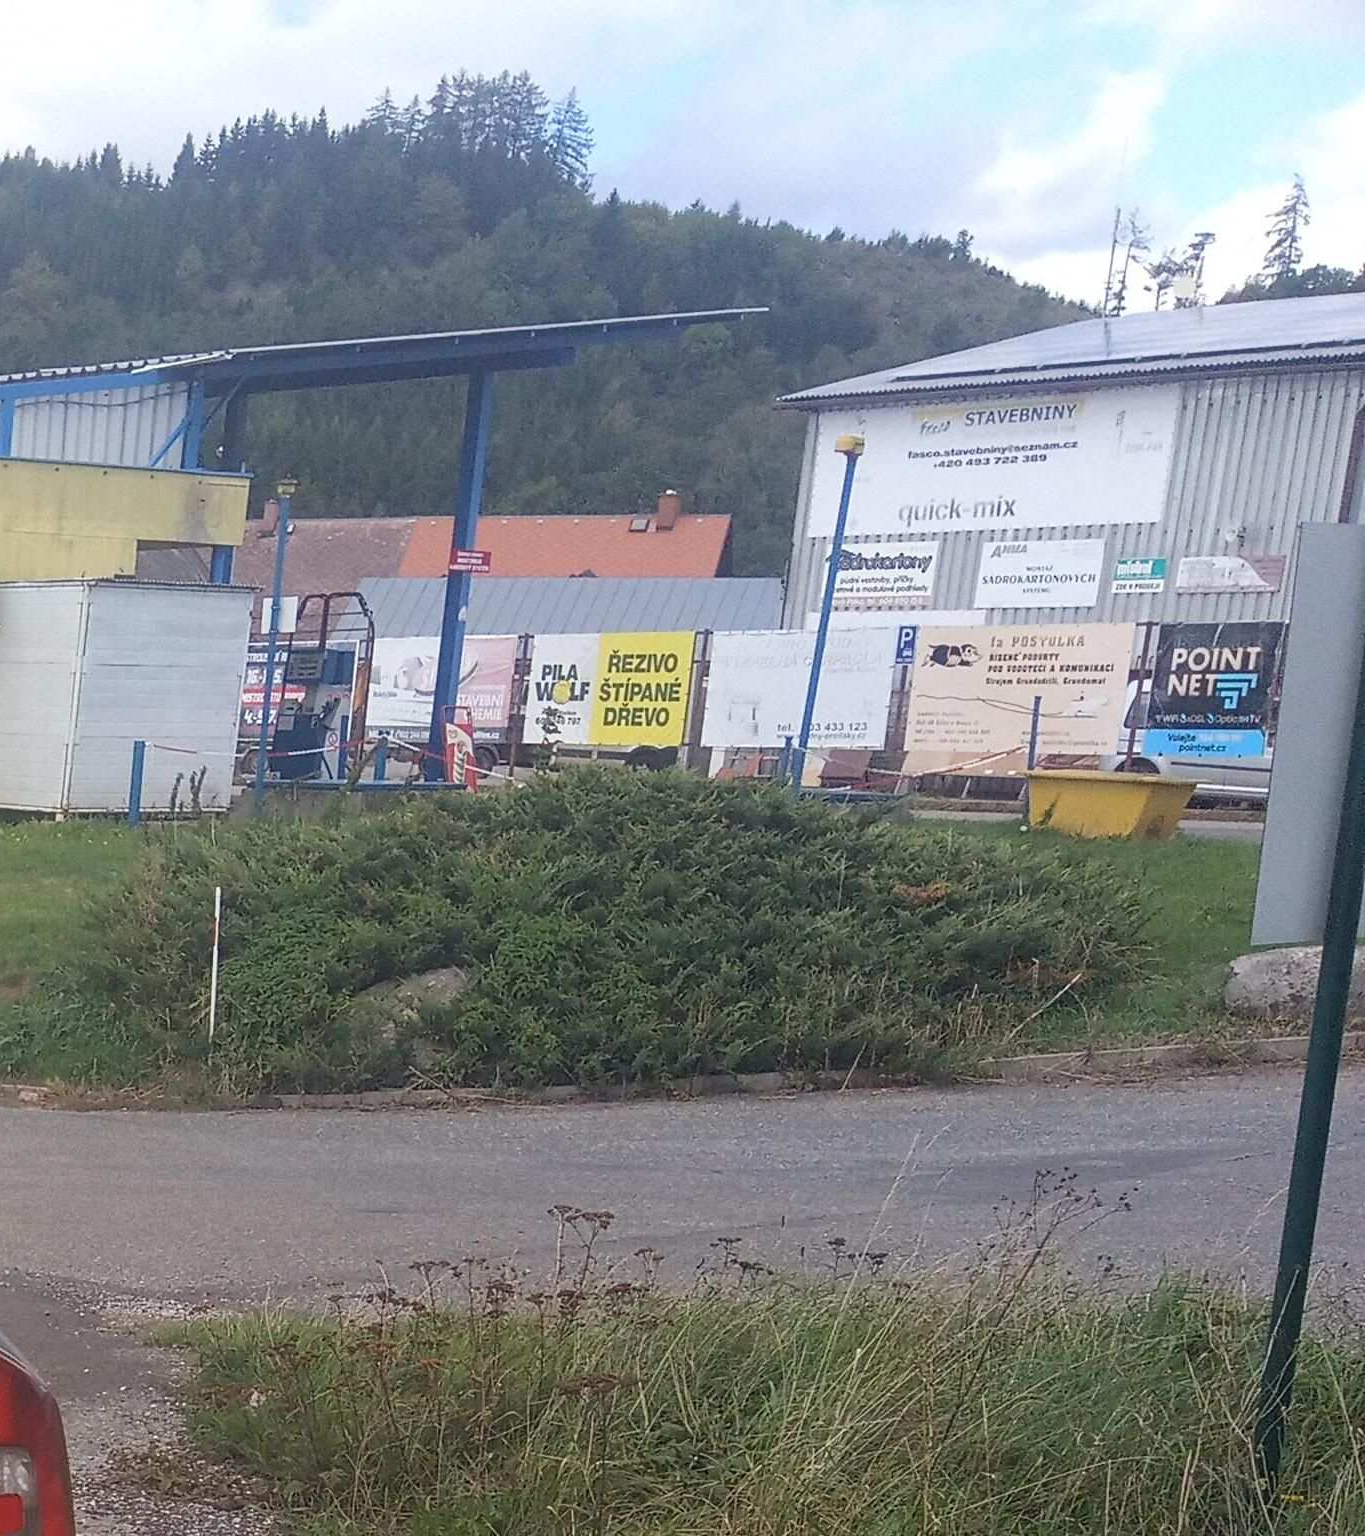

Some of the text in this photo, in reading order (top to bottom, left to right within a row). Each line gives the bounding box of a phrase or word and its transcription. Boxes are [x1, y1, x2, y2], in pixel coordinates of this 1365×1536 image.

[965, 404, 1077, 426] STAVEBNINY
[966, 458, 990, 466] 493
[898, 495, 1016, 527] quick-mix
[901, 629, 913, 648] P
[607, 650, 678, 673] ŘEZIVO
[1171, 647, 1261, 671] POINT
[541, 664, 579, 681] PILA
[599, 678, 681, 702] ŠTÍPANÉ
[1167, 674, 1217, 696] NET
[603, 703, 669, 726] DŘEVO
[777, 723, 794, 732] tel.
[824, 722, 845, 731] 433
[849, 722, 868, 731] 123
[1178, 743, 1226, 752] pointnet.cz
